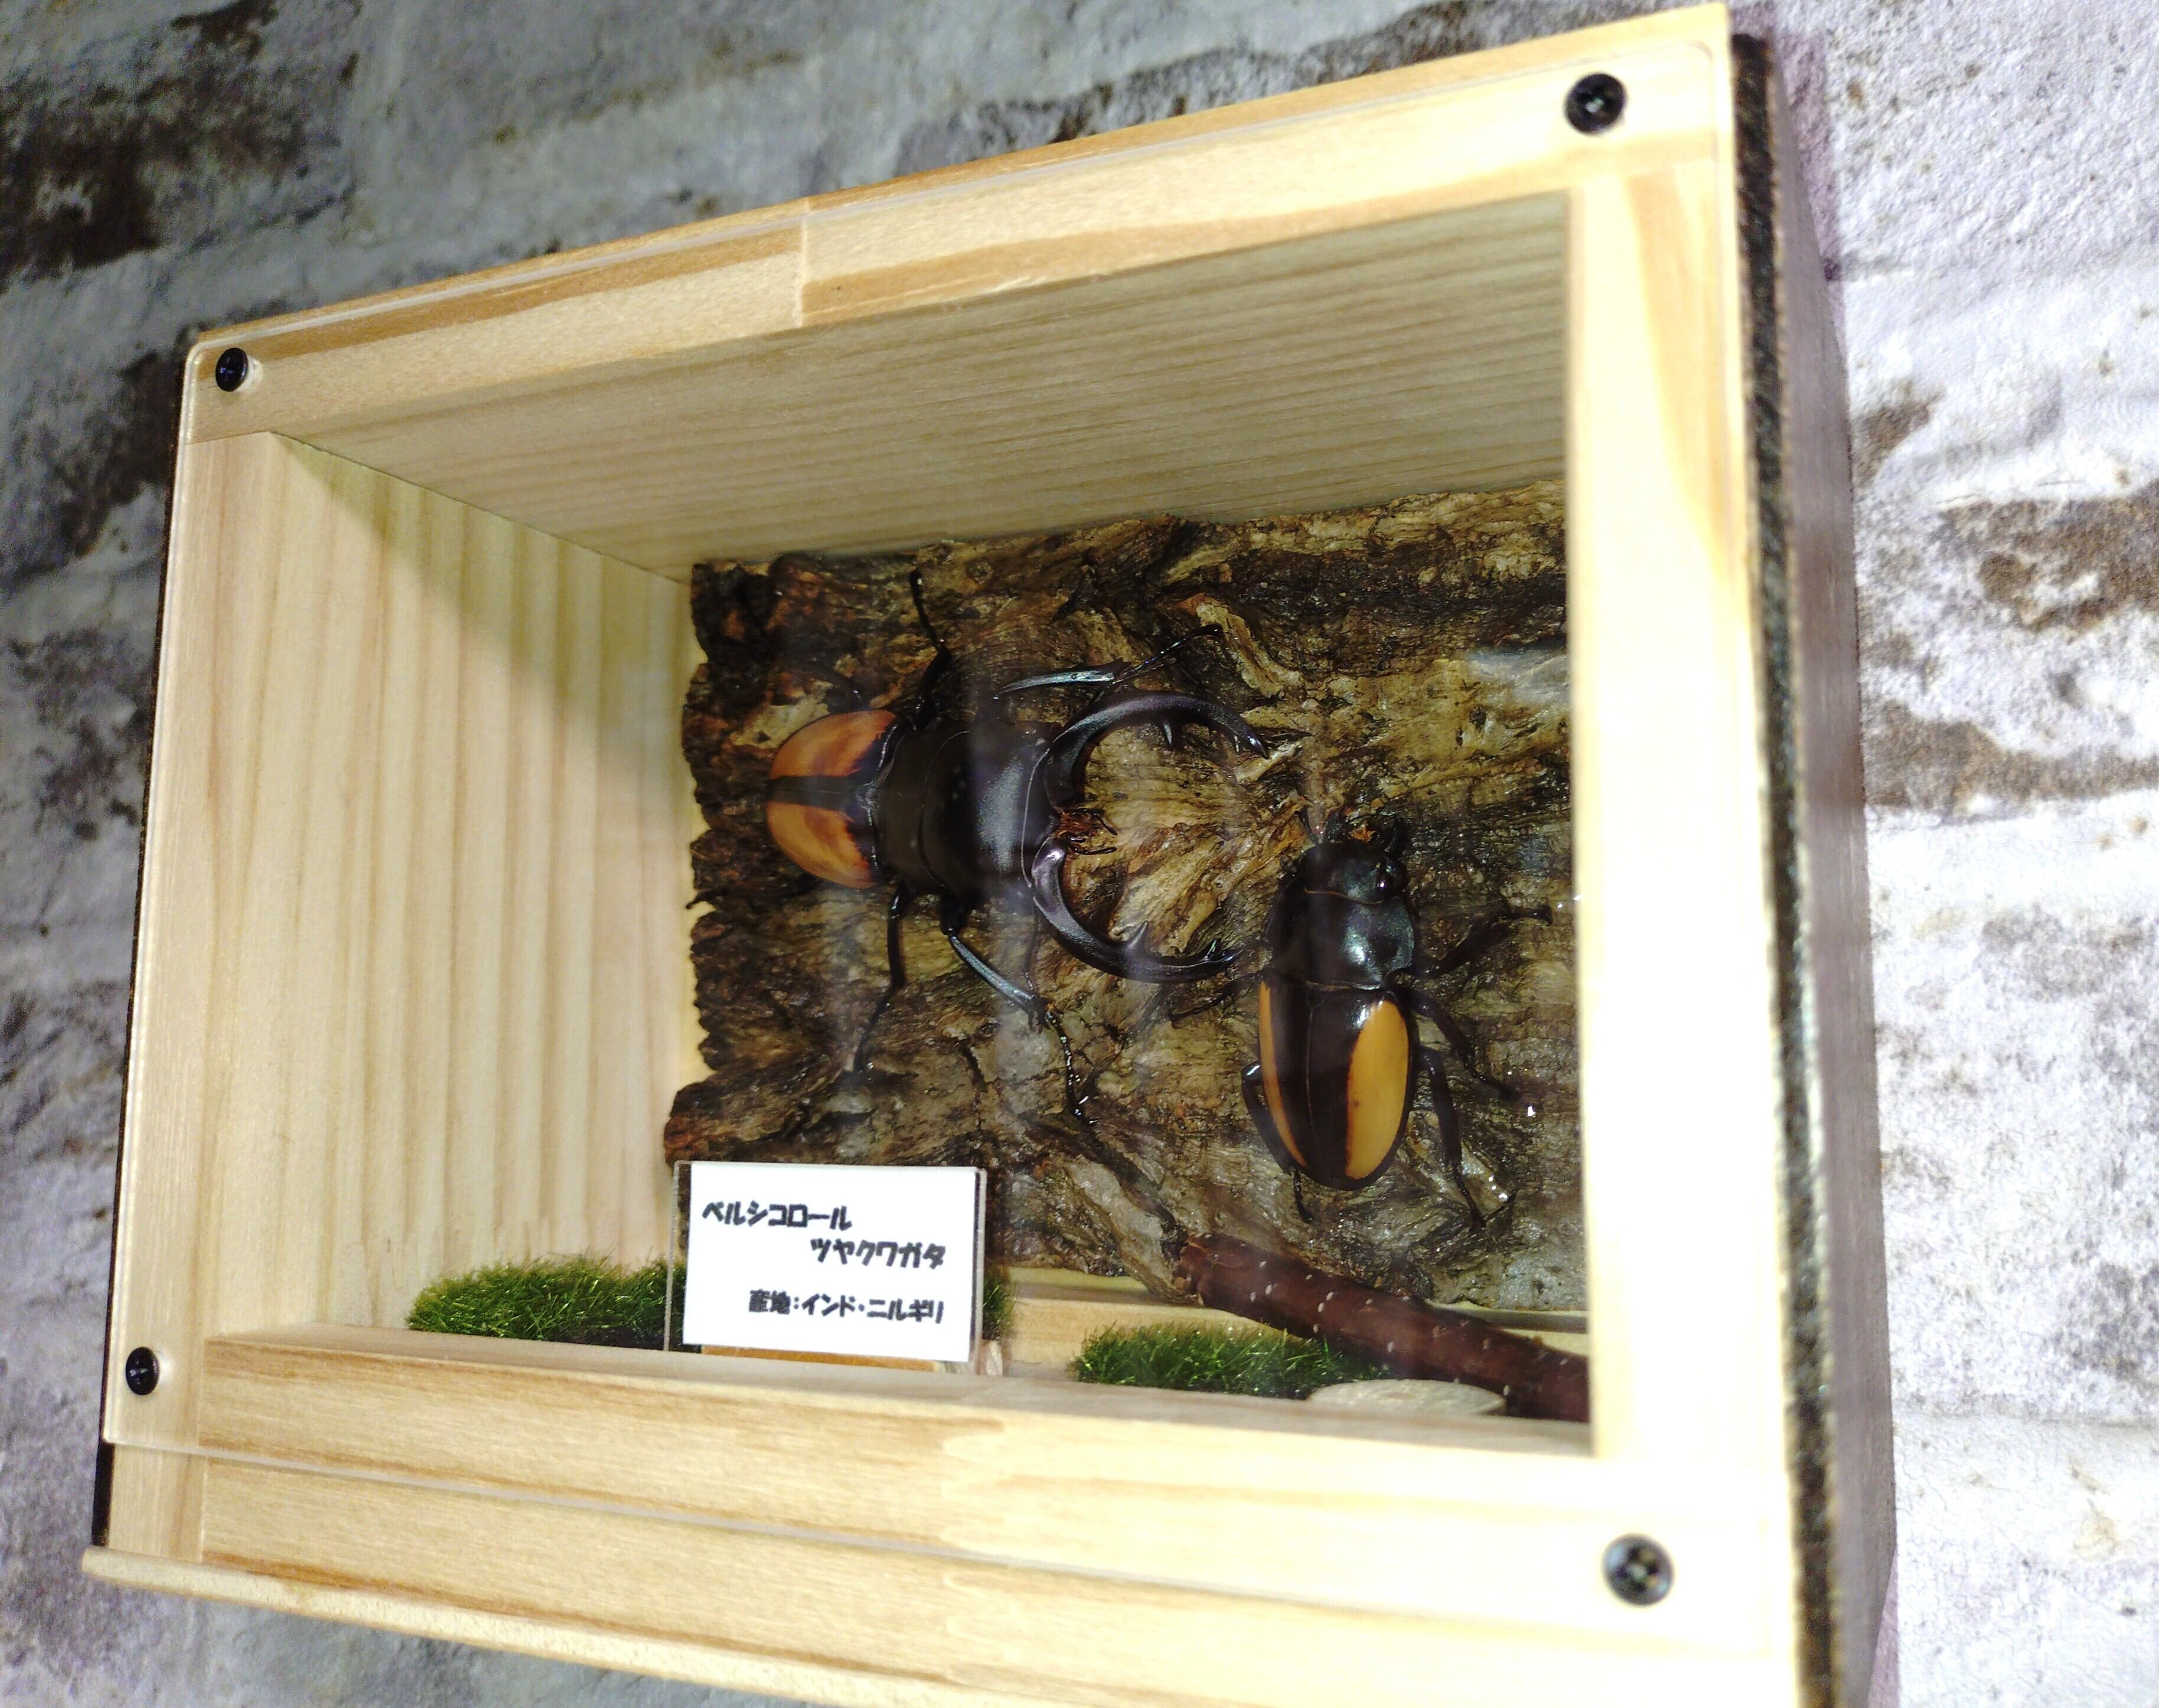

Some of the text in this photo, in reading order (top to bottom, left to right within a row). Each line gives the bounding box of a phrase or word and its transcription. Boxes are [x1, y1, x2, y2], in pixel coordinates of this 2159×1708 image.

[702, 1200, 852, 1231] ベルシコロール
[810, 1238, 945, 1269] ツヤクワガタ
